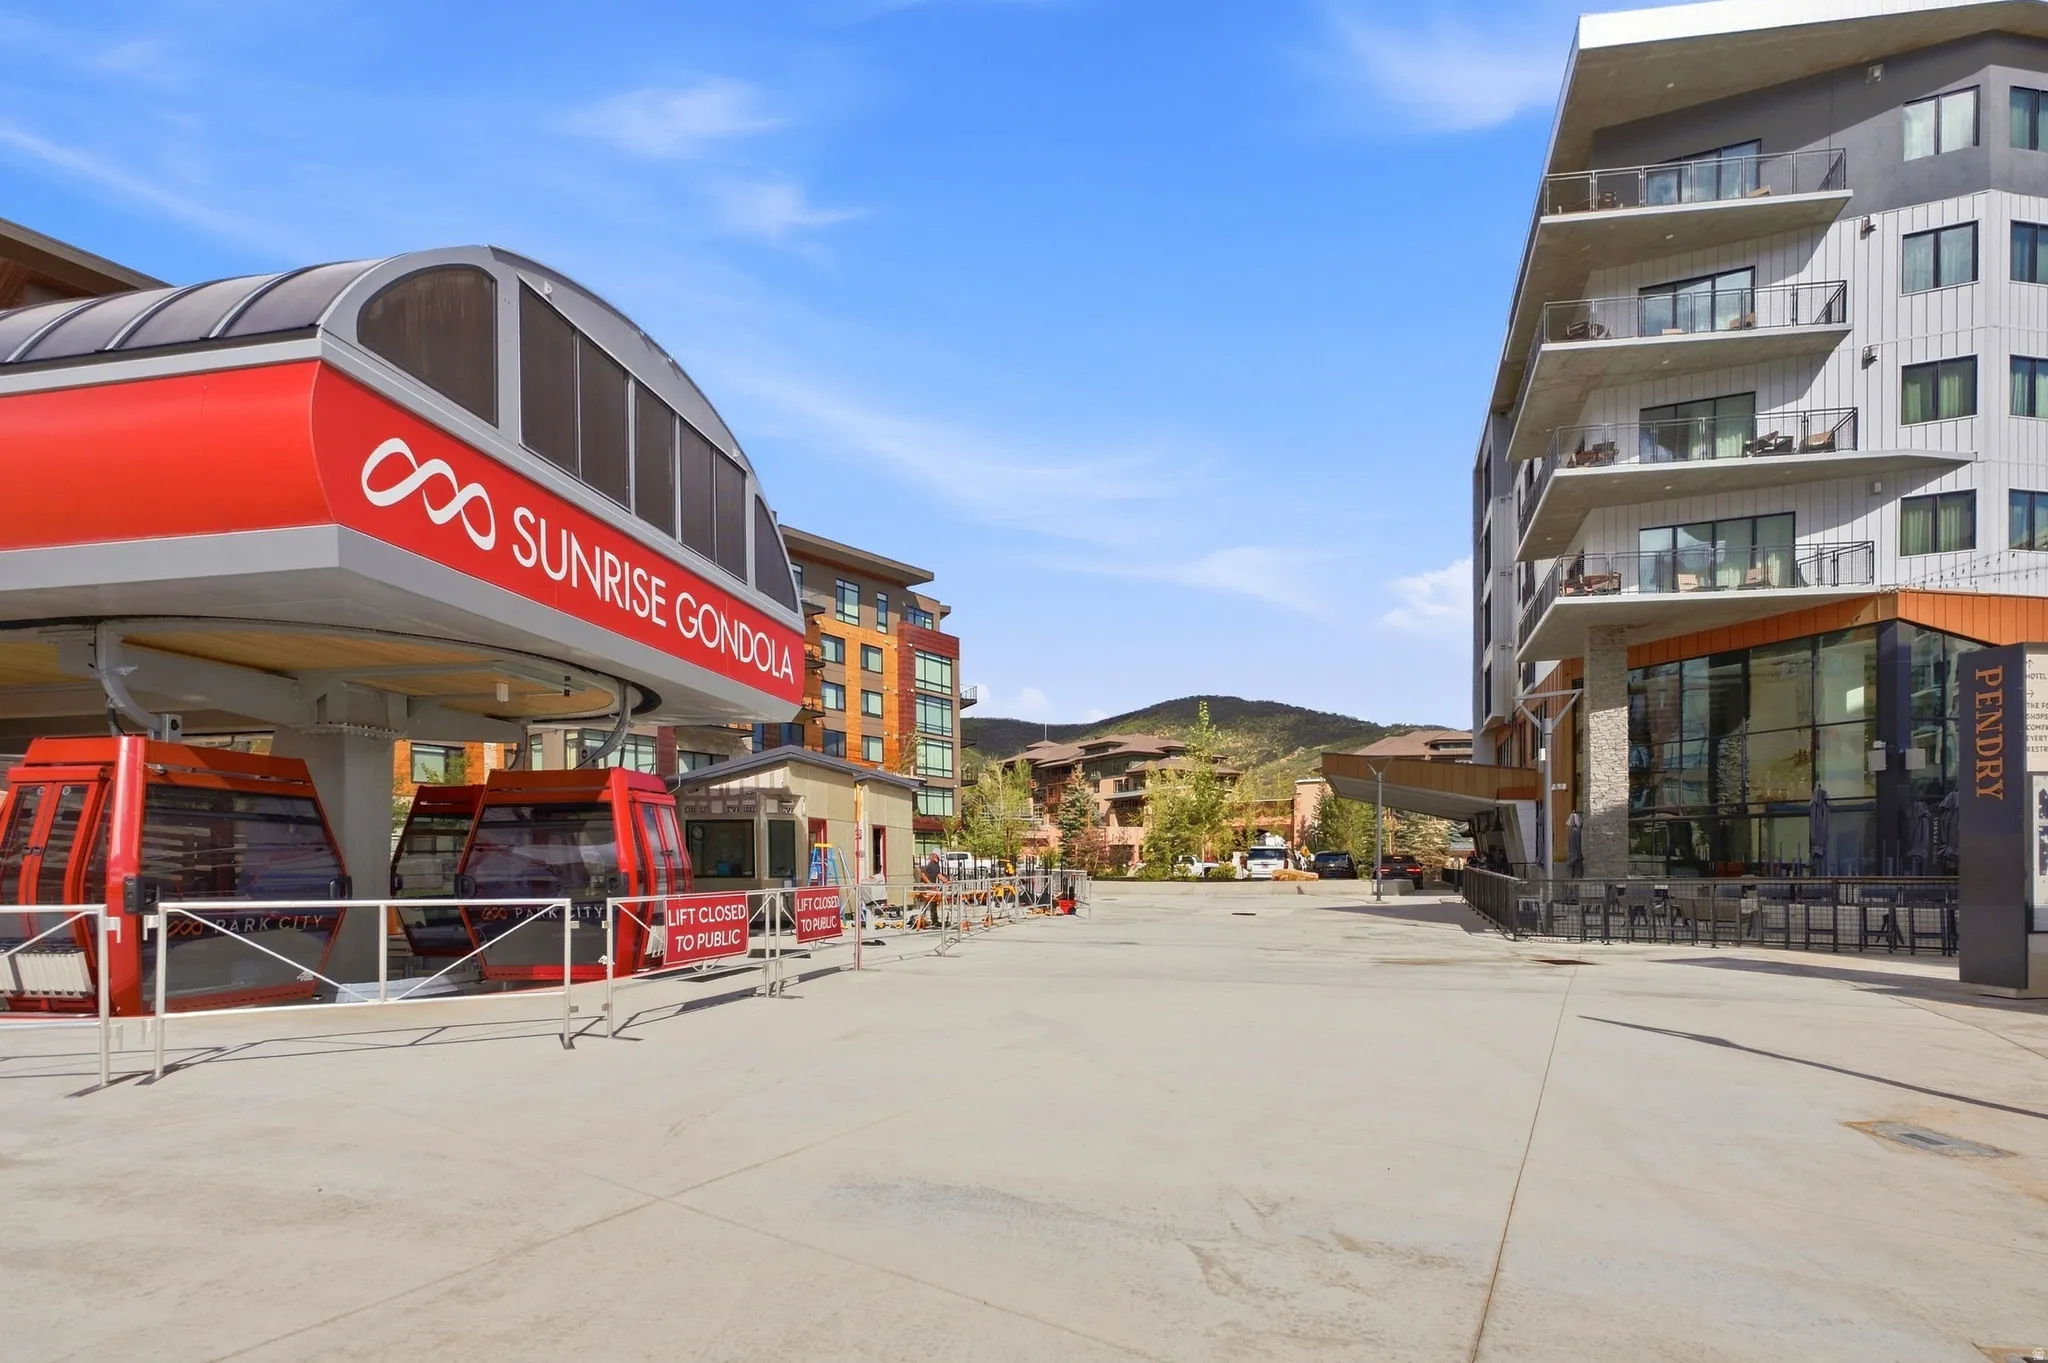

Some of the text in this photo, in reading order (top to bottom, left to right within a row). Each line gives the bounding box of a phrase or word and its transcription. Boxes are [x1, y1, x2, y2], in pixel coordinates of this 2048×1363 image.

[512, 507, 794, 684] SUNRISE GONDOLA
[1975, 665, 2004, 800] PENDRY
[797, 895, 840, 912] LIFT CLOSED
[214, 915, 324, 934] PARK CITY
[667, 904, 746, 927] LIFT CLOSED
[800, 915, 837, 932] TO PUBLIC
[676, 929, 741, 952] TO PUBLIC
